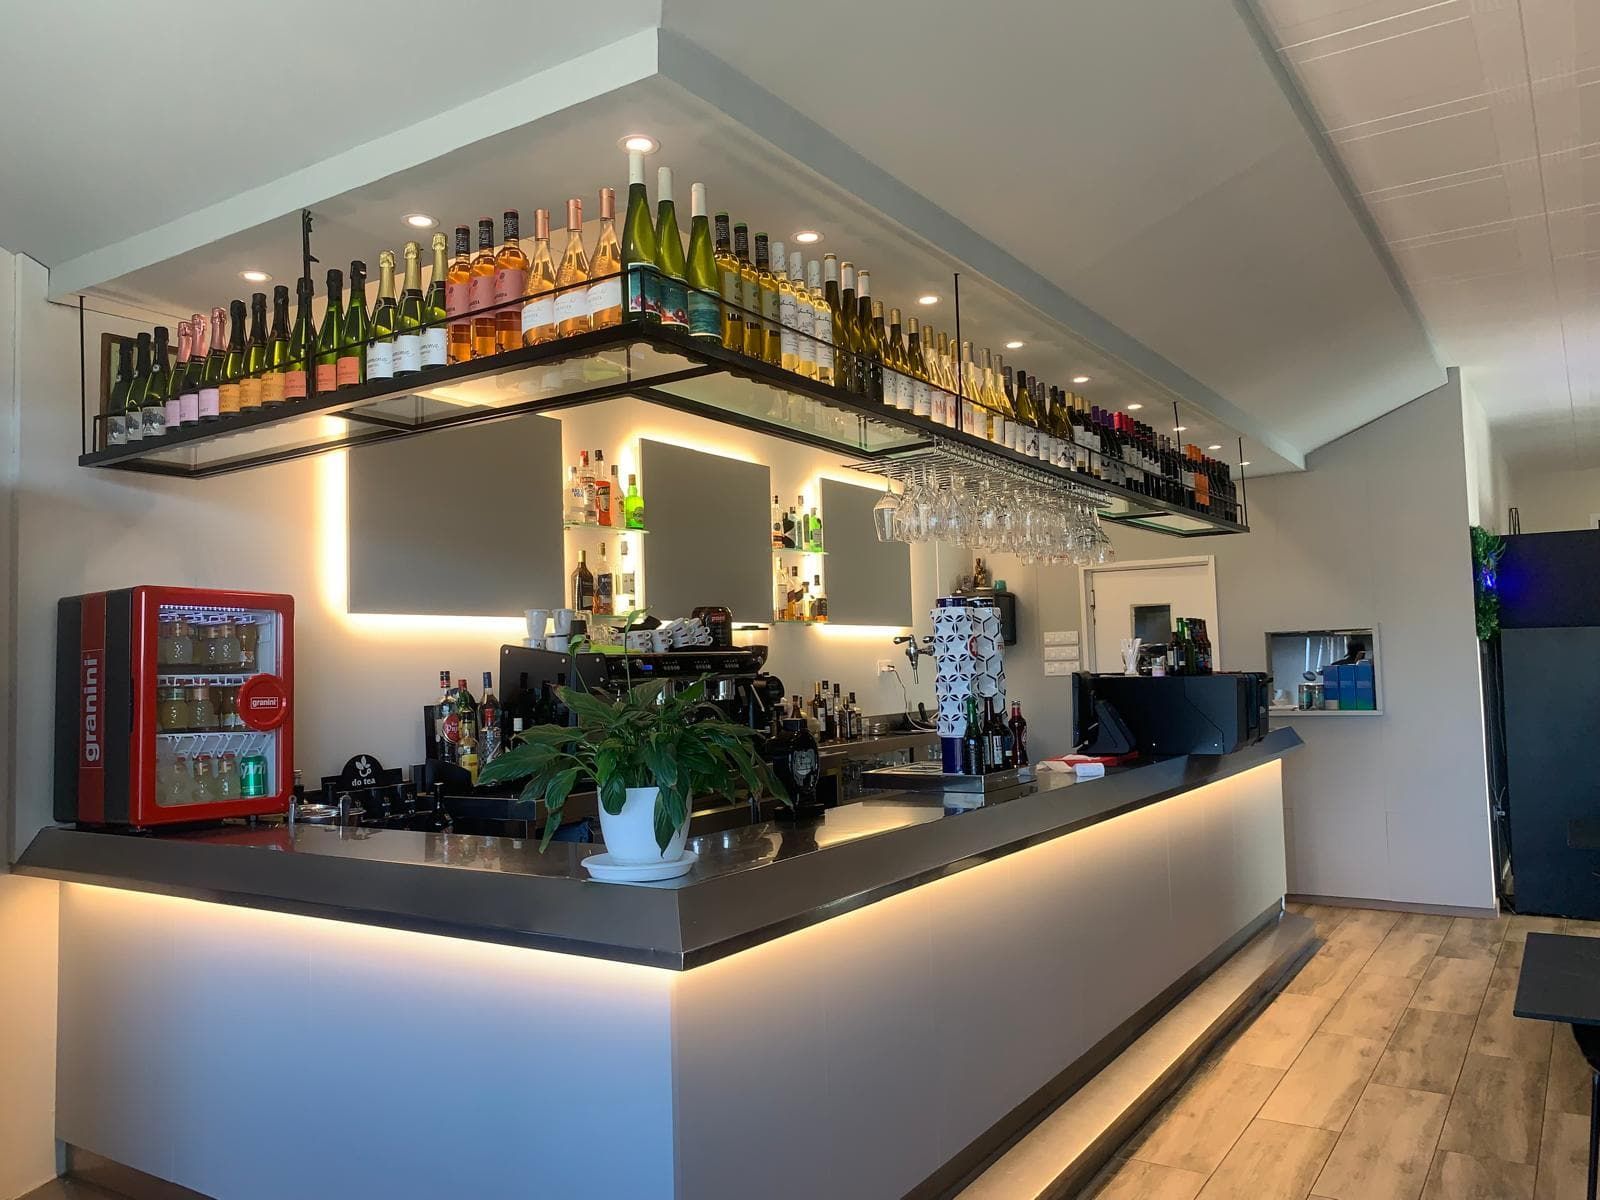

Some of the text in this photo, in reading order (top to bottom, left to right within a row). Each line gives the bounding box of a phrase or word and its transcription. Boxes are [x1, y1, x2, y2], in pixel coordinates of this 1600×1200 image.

[252, 698, 277, 708] granini
[84, 657, 100, 762] granini
[351, 778, 362, 787] do
